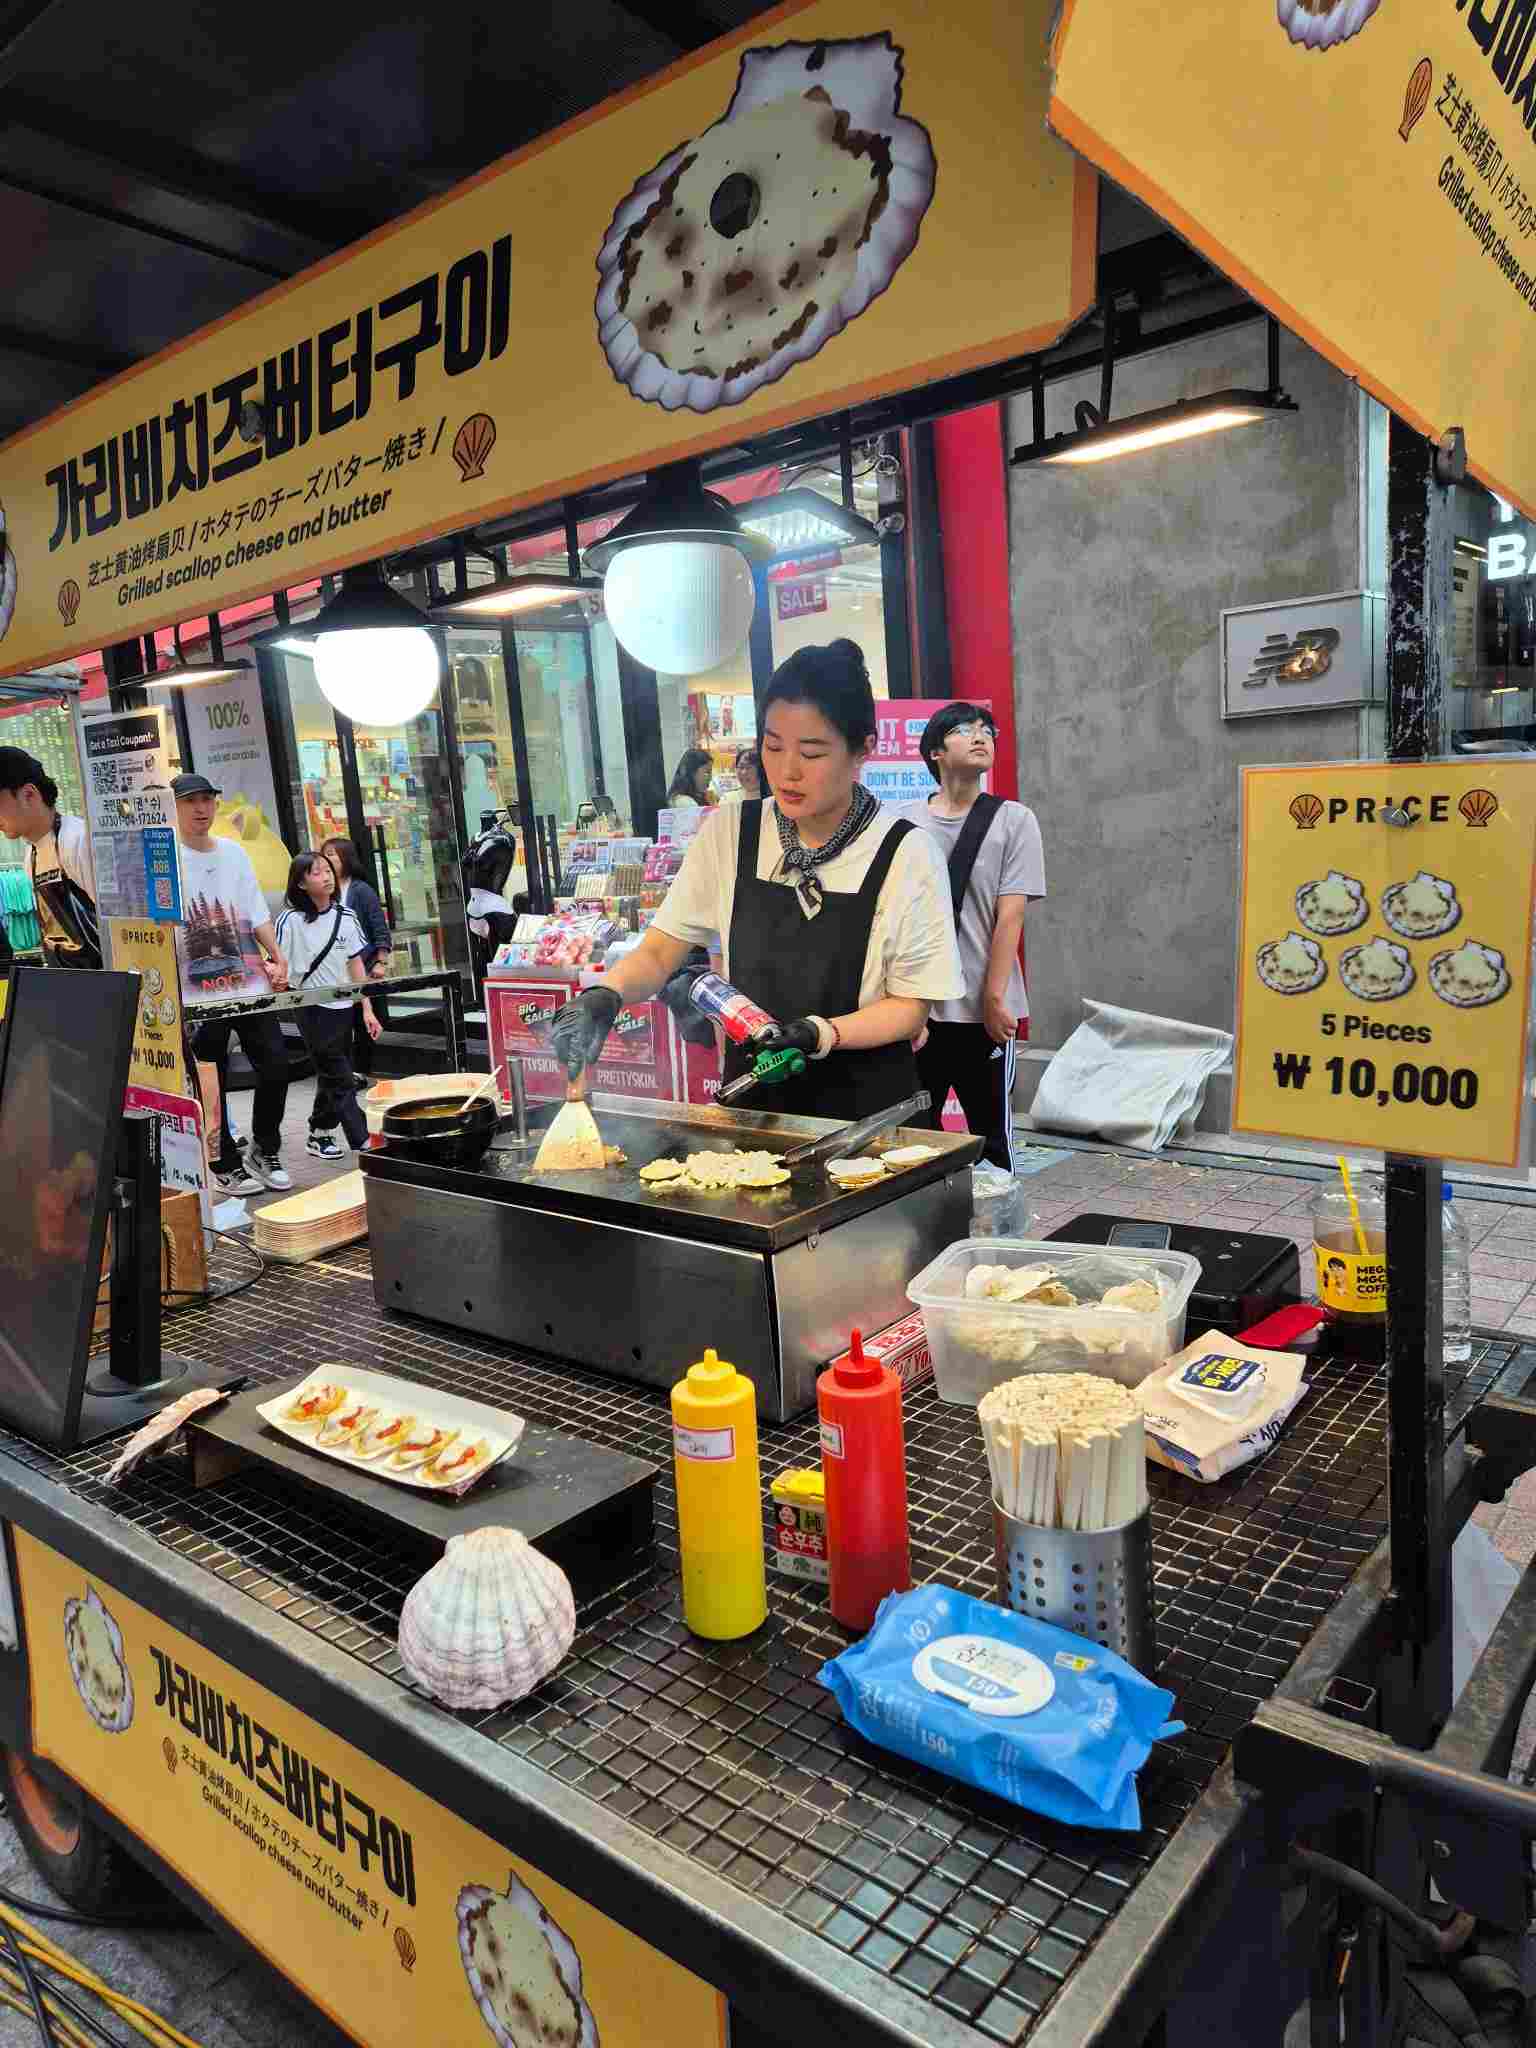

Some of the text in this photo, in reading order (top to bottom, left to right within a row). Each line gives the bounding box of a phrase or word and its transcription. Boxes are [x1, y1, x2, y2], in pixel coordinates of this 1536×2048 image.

[1438, 154, 1475, 215] Grilled
[1464, 201, 1497, 257] scallop
[1491, 235, 1521, 283] cheese
[45, 233, 513, 553] 가리비치즈버터구이
[117, 487, 392, 608] Grilled scallop cheese and butter
[1487, 533, 1536, 580] B
[779, 589, 825, 609] SALE
[205, 700, 249, 731] 100%
[128, 929, 158, 943] PRICE
[617, 1016, 647, 1034] SALE
[1320, 1013, 1432, 1044] 5 Pieces
[142, 1046, 176, 1070] 10,000
[1324, 1055, 1479, 1110] 10,000
[1356, 1265, 1386, 1274] MEG
[779, 1529, 825, 1553] 순후추
[149, 1644, 417, 1907] 가리비치즈버터구이
[201, 1785, 364, 1931] Grilled scallop cheese and butter
